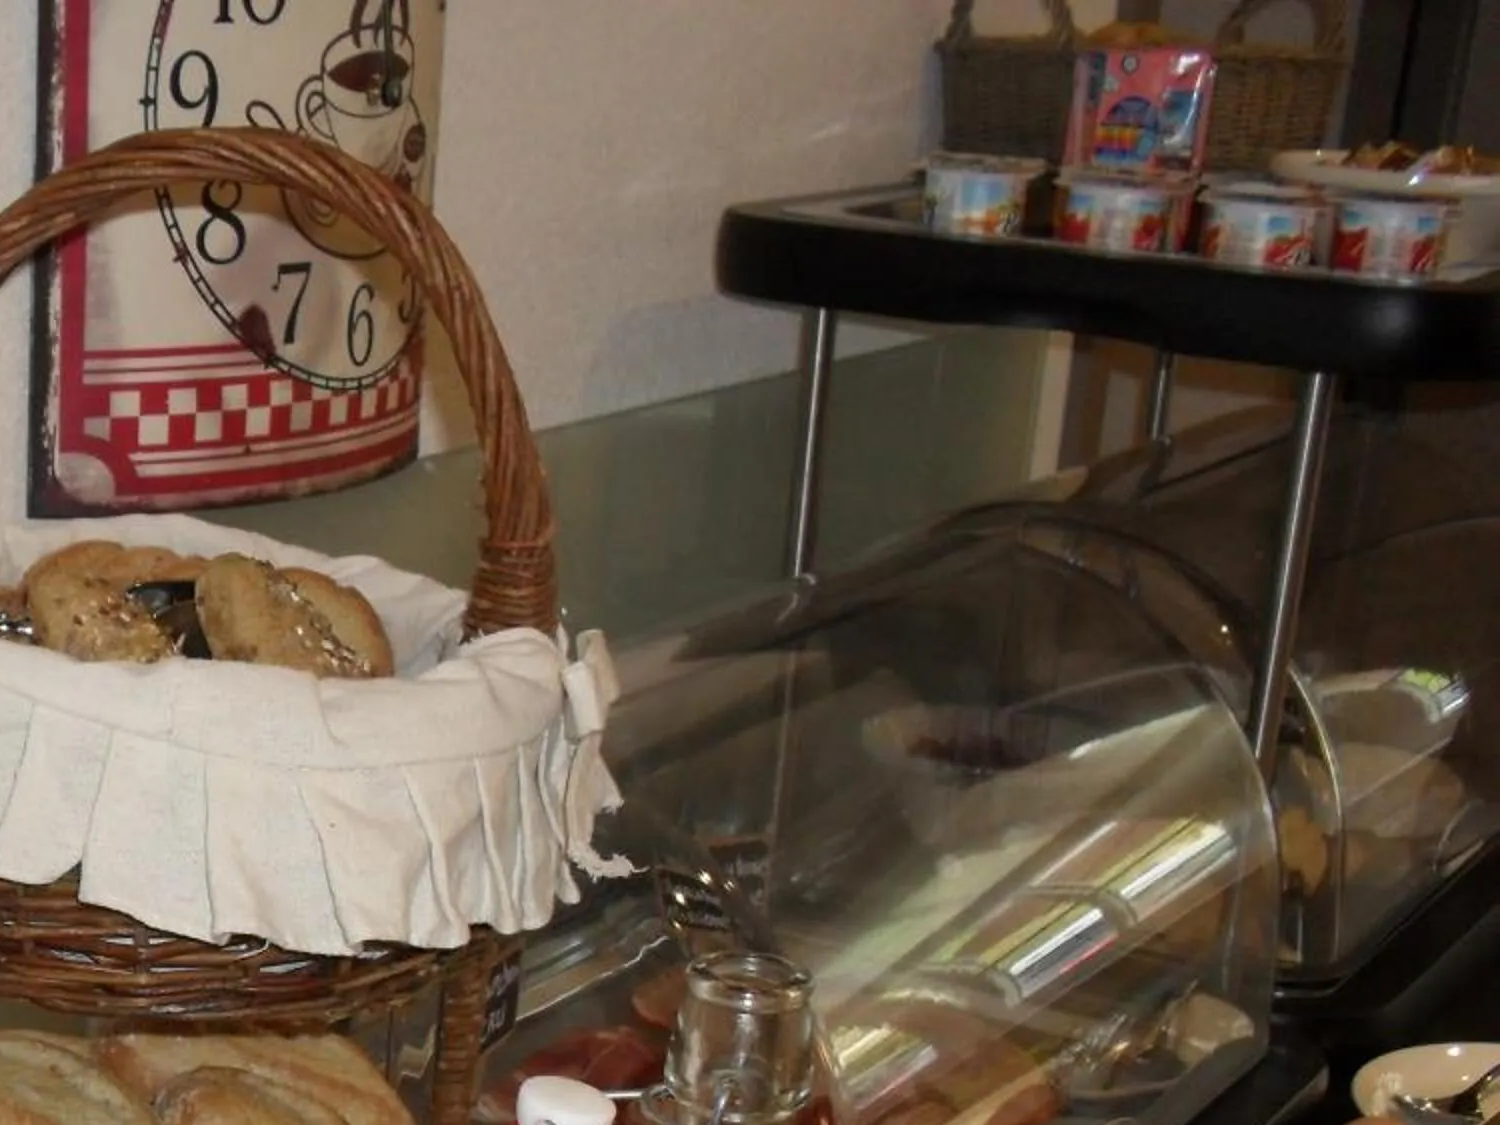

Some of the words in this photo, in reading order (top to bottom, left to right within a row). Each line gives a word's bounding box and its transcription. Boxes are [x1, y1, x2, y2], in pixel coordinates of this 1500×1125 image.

[170, 50, 219, 128] 9
[196, 179, 246, 265] 8
[271, 262, 312, 345] 7
[347, 282, 374, 366] 6
